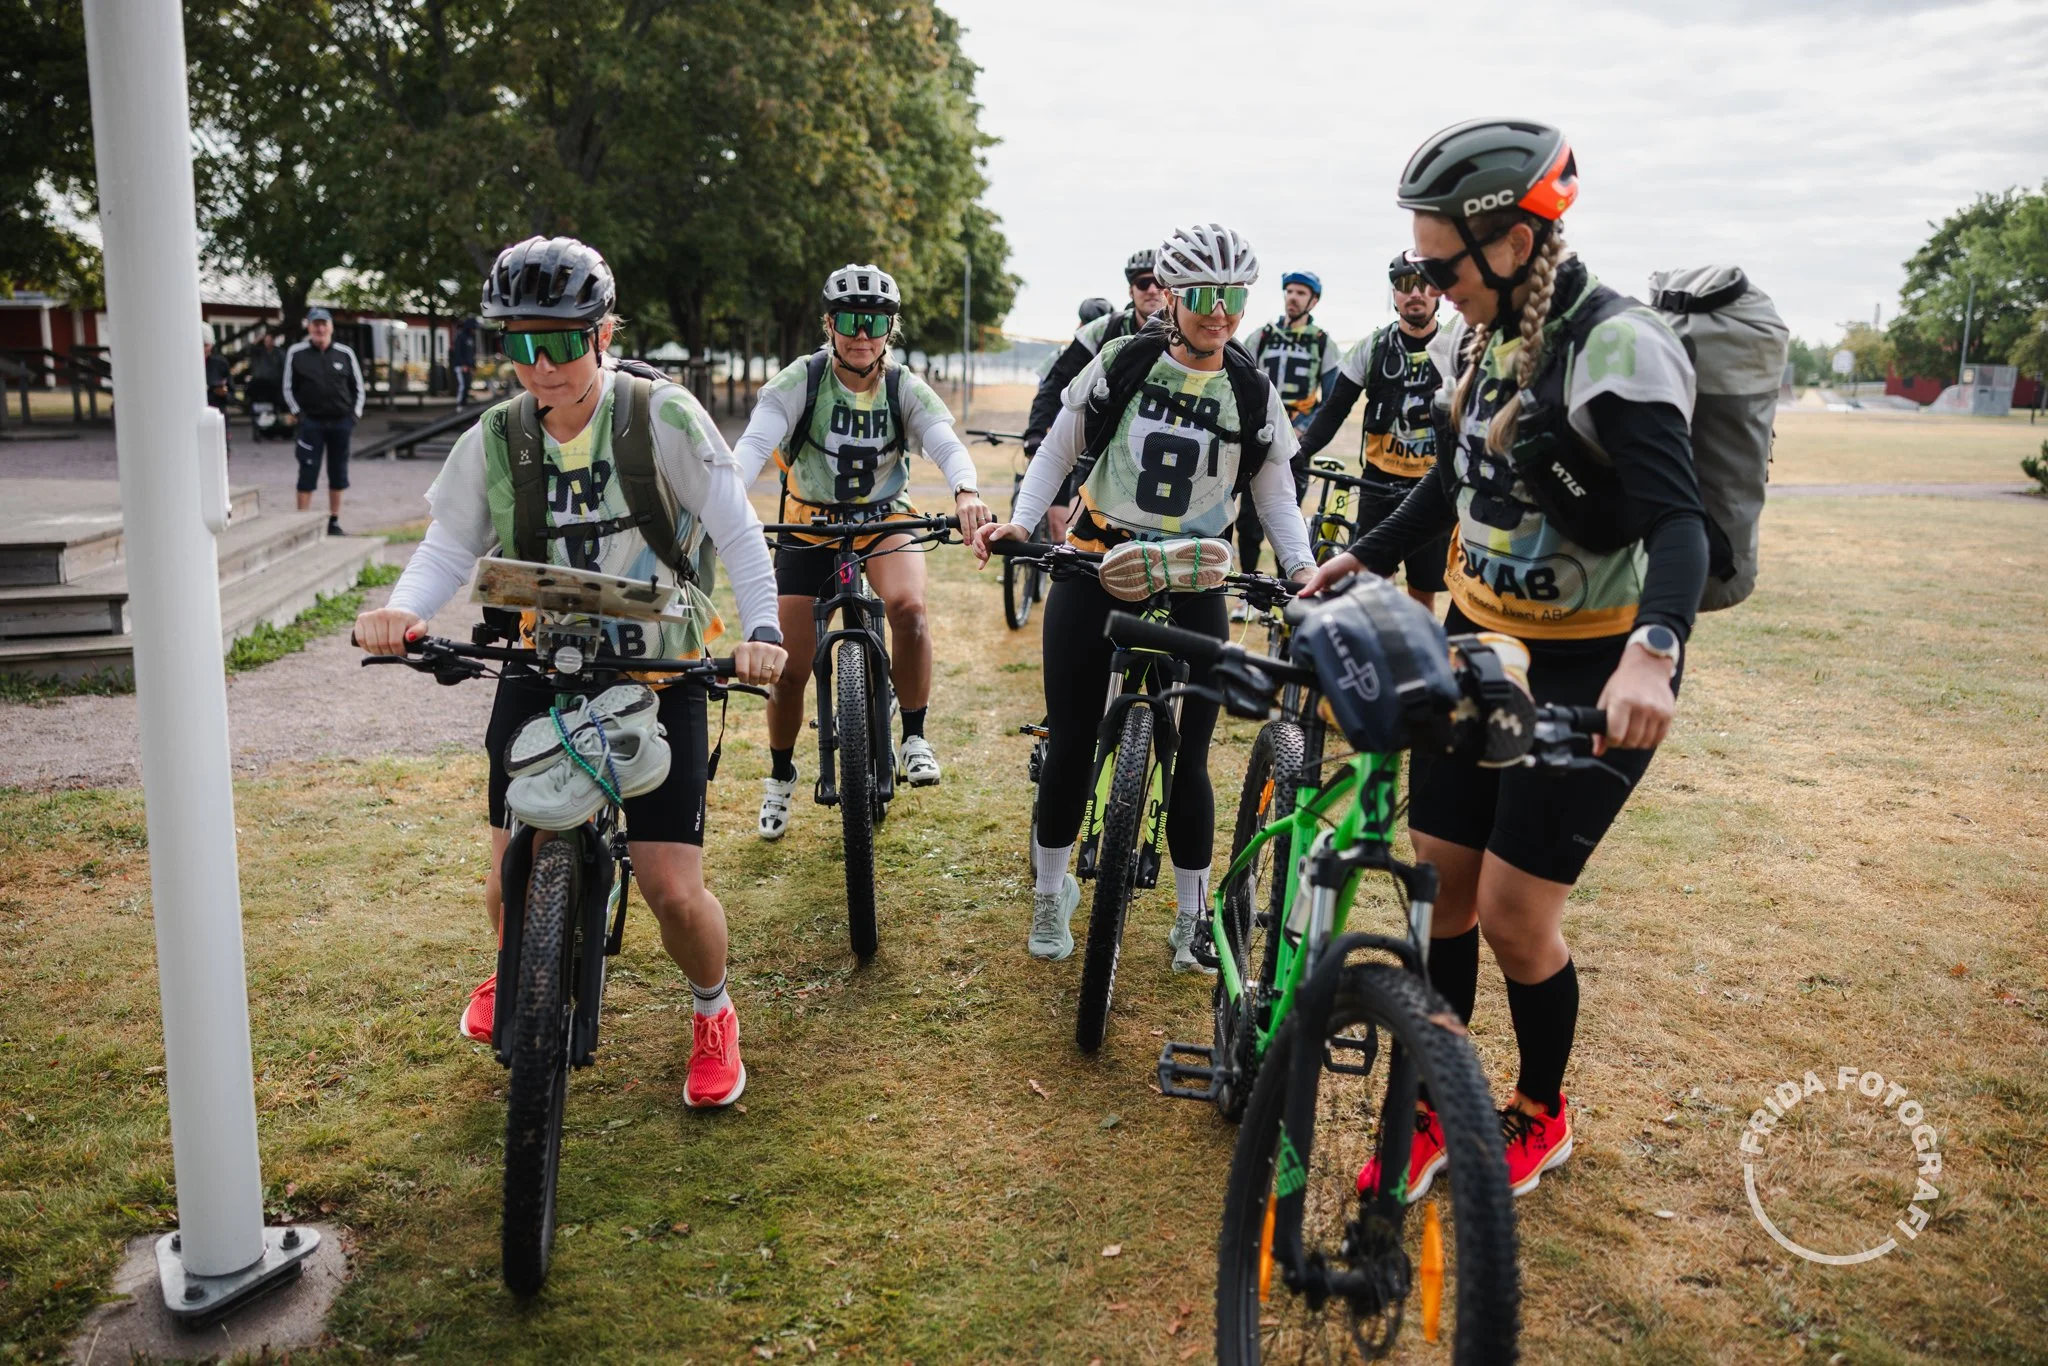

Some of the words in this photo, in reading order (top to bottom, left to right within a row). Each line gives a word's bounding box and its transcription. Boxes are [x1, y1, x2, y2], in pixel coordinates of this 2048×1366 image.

[1263, 356, 1312, 399] 15
[834, 443, 878, 501] 8
[1385, 437, 1437, 458] JOKA
[1135, 431, 1201, 517] 8
